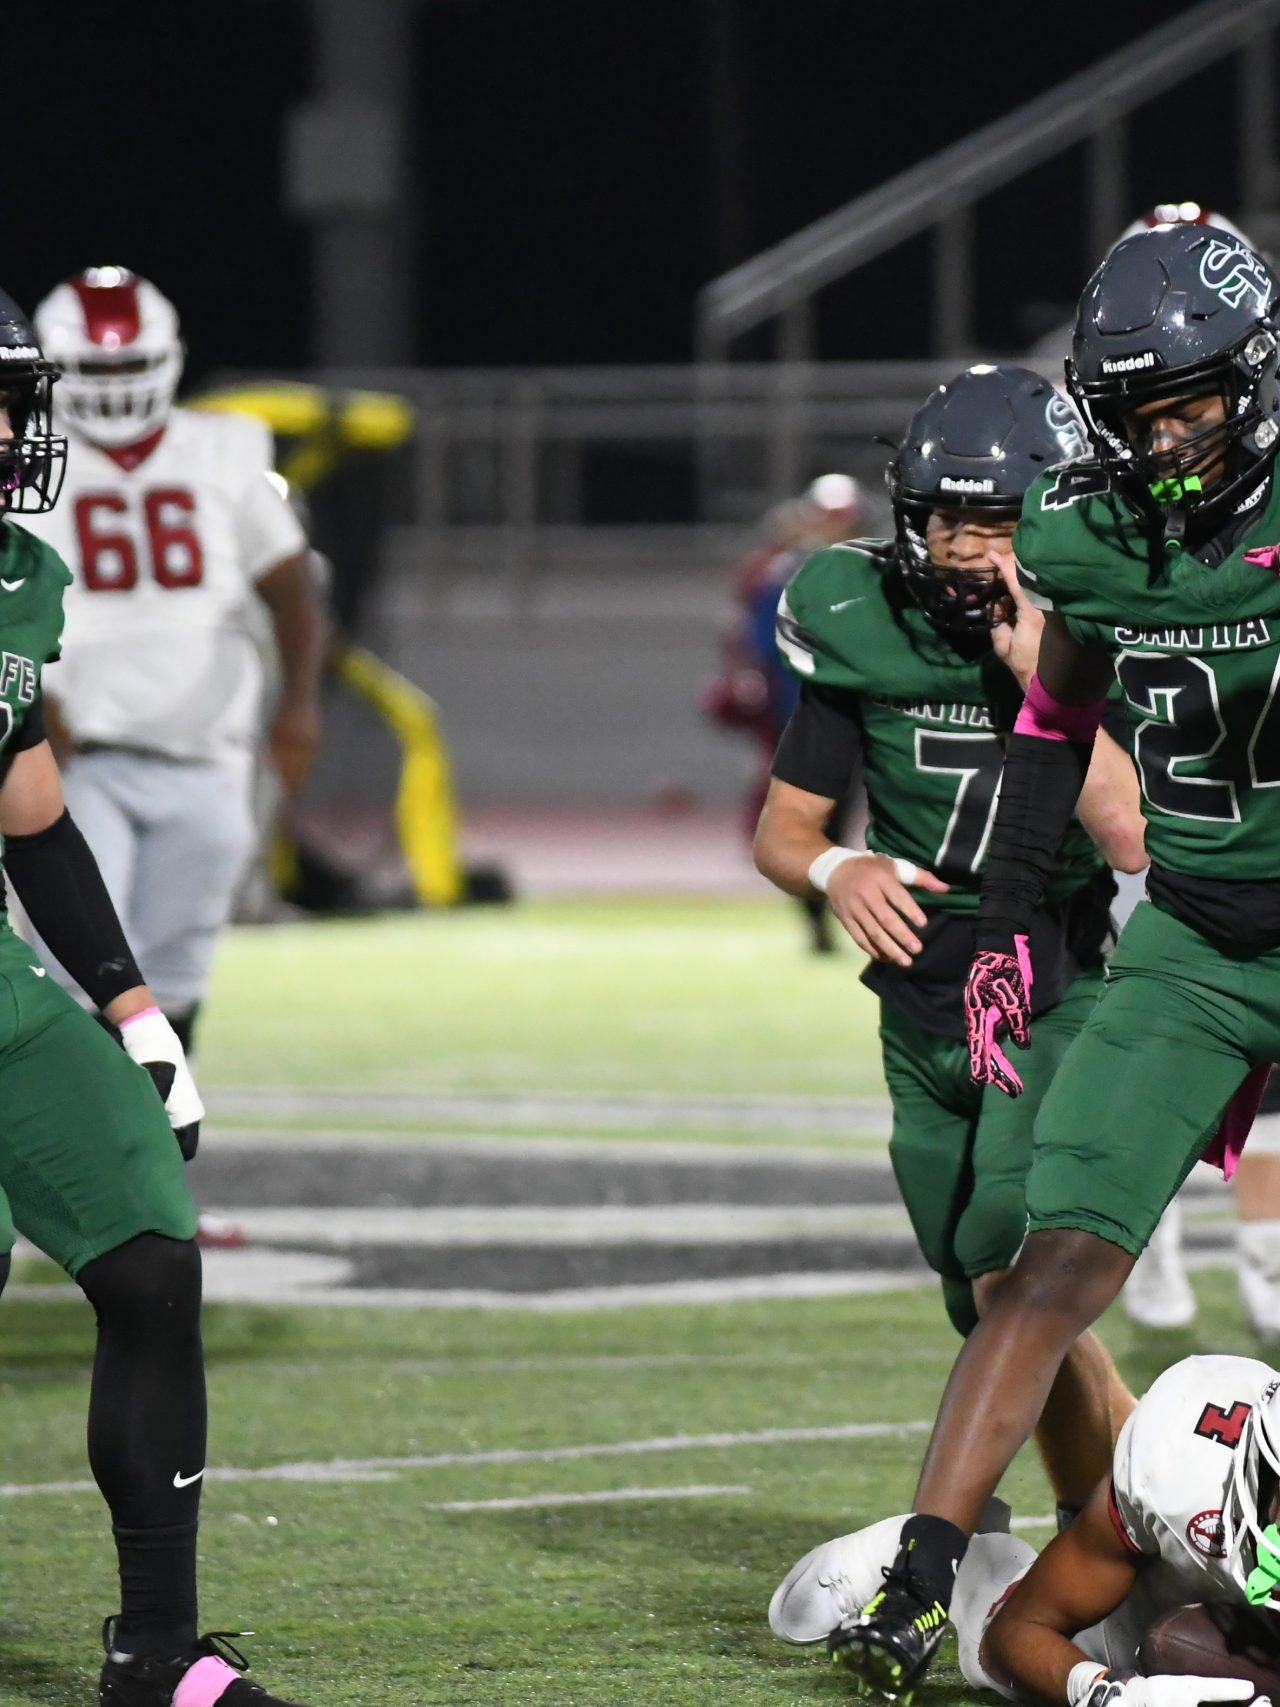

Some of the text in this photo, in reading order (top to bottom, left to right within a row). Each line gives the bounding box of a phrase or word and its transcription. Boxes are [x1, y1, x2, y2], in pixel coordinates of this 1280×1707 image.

[940, 477, 994, 493] Riddell
[73, 485, 205, 592] 66
[0, 651, 36, 703] FE
[914, 727, 1007, 875] 7
